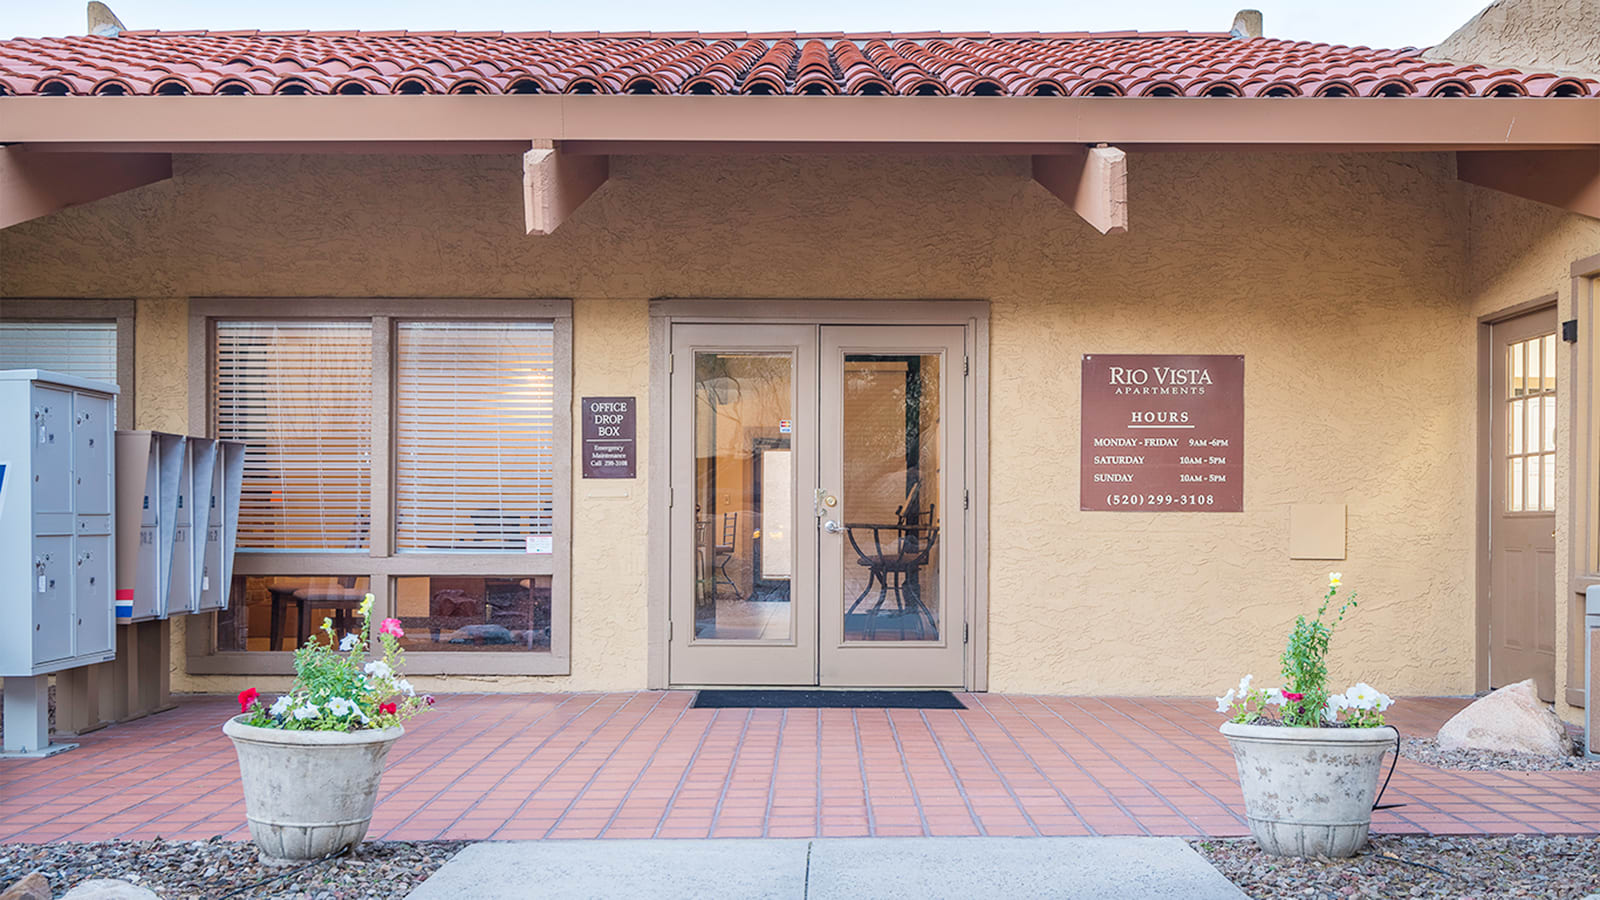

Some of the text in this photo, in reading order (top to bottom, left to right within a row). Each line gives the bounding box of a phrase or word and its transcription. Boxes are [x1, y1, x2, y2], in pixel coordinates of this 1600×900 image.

[1109, 366, 1213, 385] RIO VISTA
[1115, 387, 1206, 395] APARTMENTS
[590, 402, 627, 413] OFFICE
[594, 414, 624, 425] DROP
[1131, 412, 1190, 423] HOURS
[598, 426, 620, 437] BOX
[1093, 438, 1138, 447] MONDAY
[1144, 438, 1179, 447] FRIDAY
[593, 445, 625, 453] Emergency
[1093, 456, 1145, 465] SATURDAY
[1179, 456, 1202, 465] 10AM
[1208, 456, 1226, 465] 5PM
[1093, 473, 1134, 482] SUNDAY
[1179, 473, 1202, 482] 10AM
[1208, 473, 1226, 482] 5PM
[1106, 494, 1214, 506] (520) 299-3108
